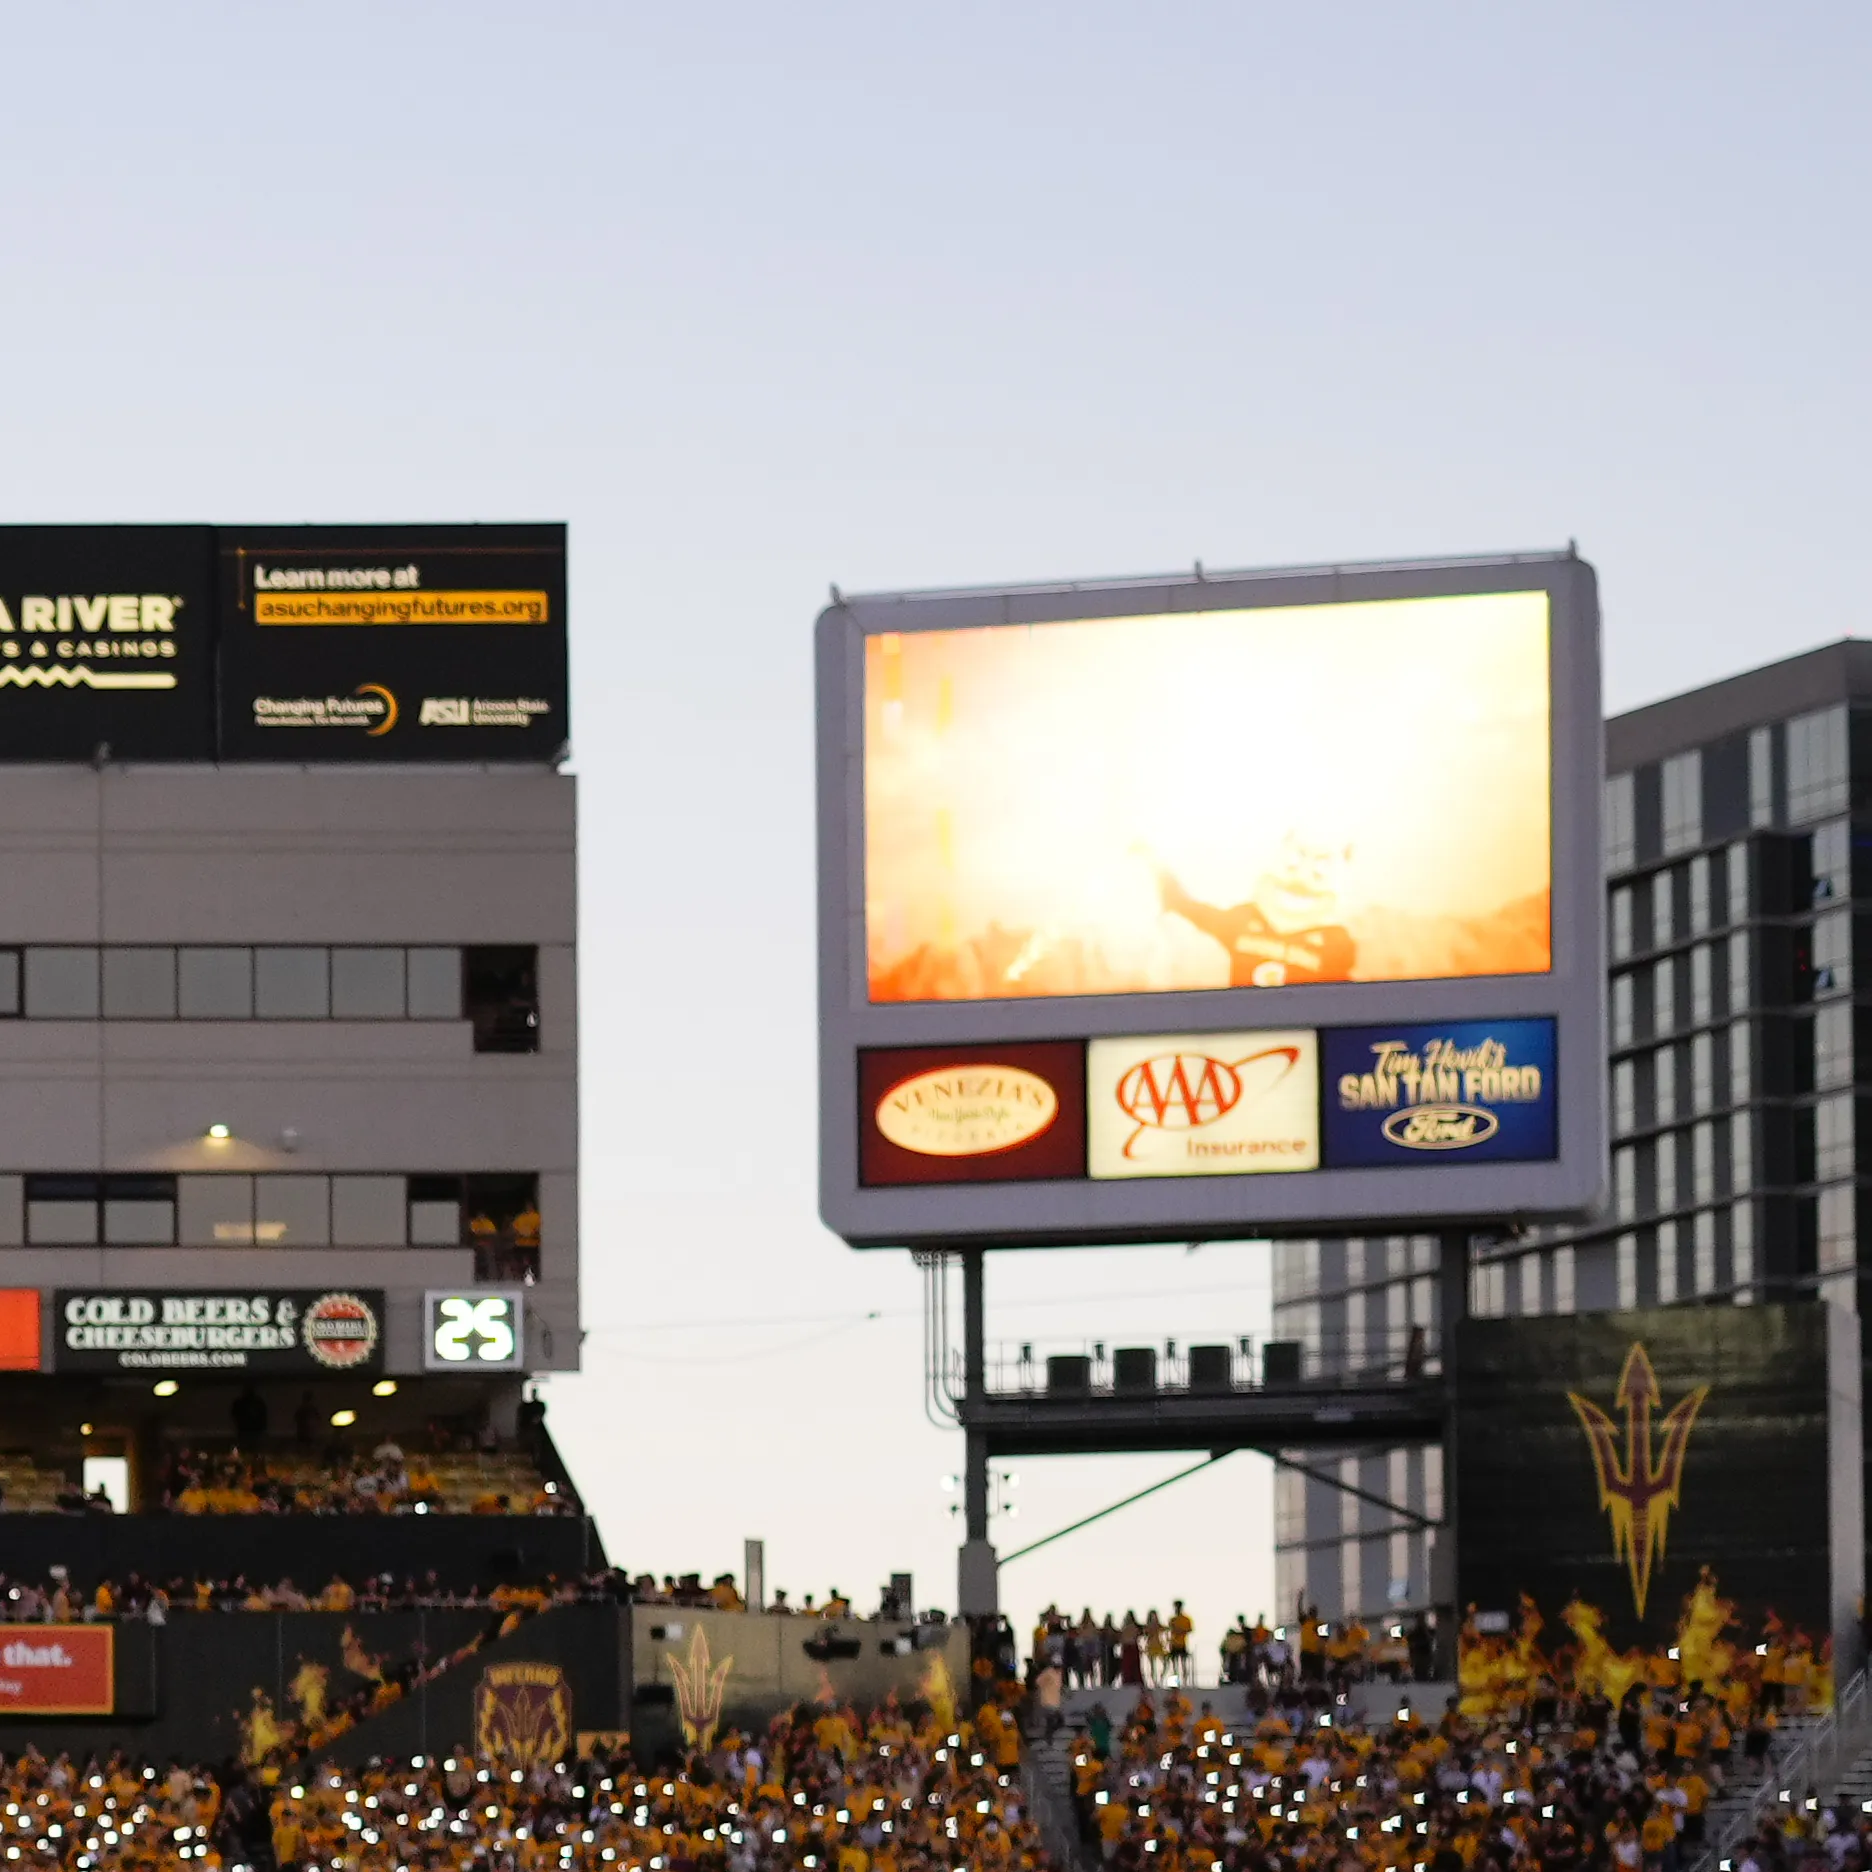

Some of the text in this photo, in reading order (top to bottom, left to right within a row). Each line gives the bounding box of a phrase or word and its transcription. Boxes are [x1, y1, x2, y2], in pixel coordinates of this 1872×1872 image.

[255, 564, 421, 590] Learn more at
[21, 595, 175, 633] RIVER
[261, 598, 543, 623] asuchangingfutures.org
[29, 639, 47, 660] &
[56, 639, 177, 660] CASINOS
[892, 1078, 1044, 1113] VENEZIA'S
[1130, 1054, 1232, 1127] AAA
[1337, 1065, 1543, 1112] SAN TAN FORD
[1186, 1136, 1307, 1157] Insurance
[65, 1297, 298, 1326] COLD BEERS &
[65, 1324, 296, 1350] CHEESEBURGERS
[435, 1297, 515, 1361] 25
[119, 1350, 248, 1368] COLDBEERS.COM
[3, 1641, 74, 1668] that.
